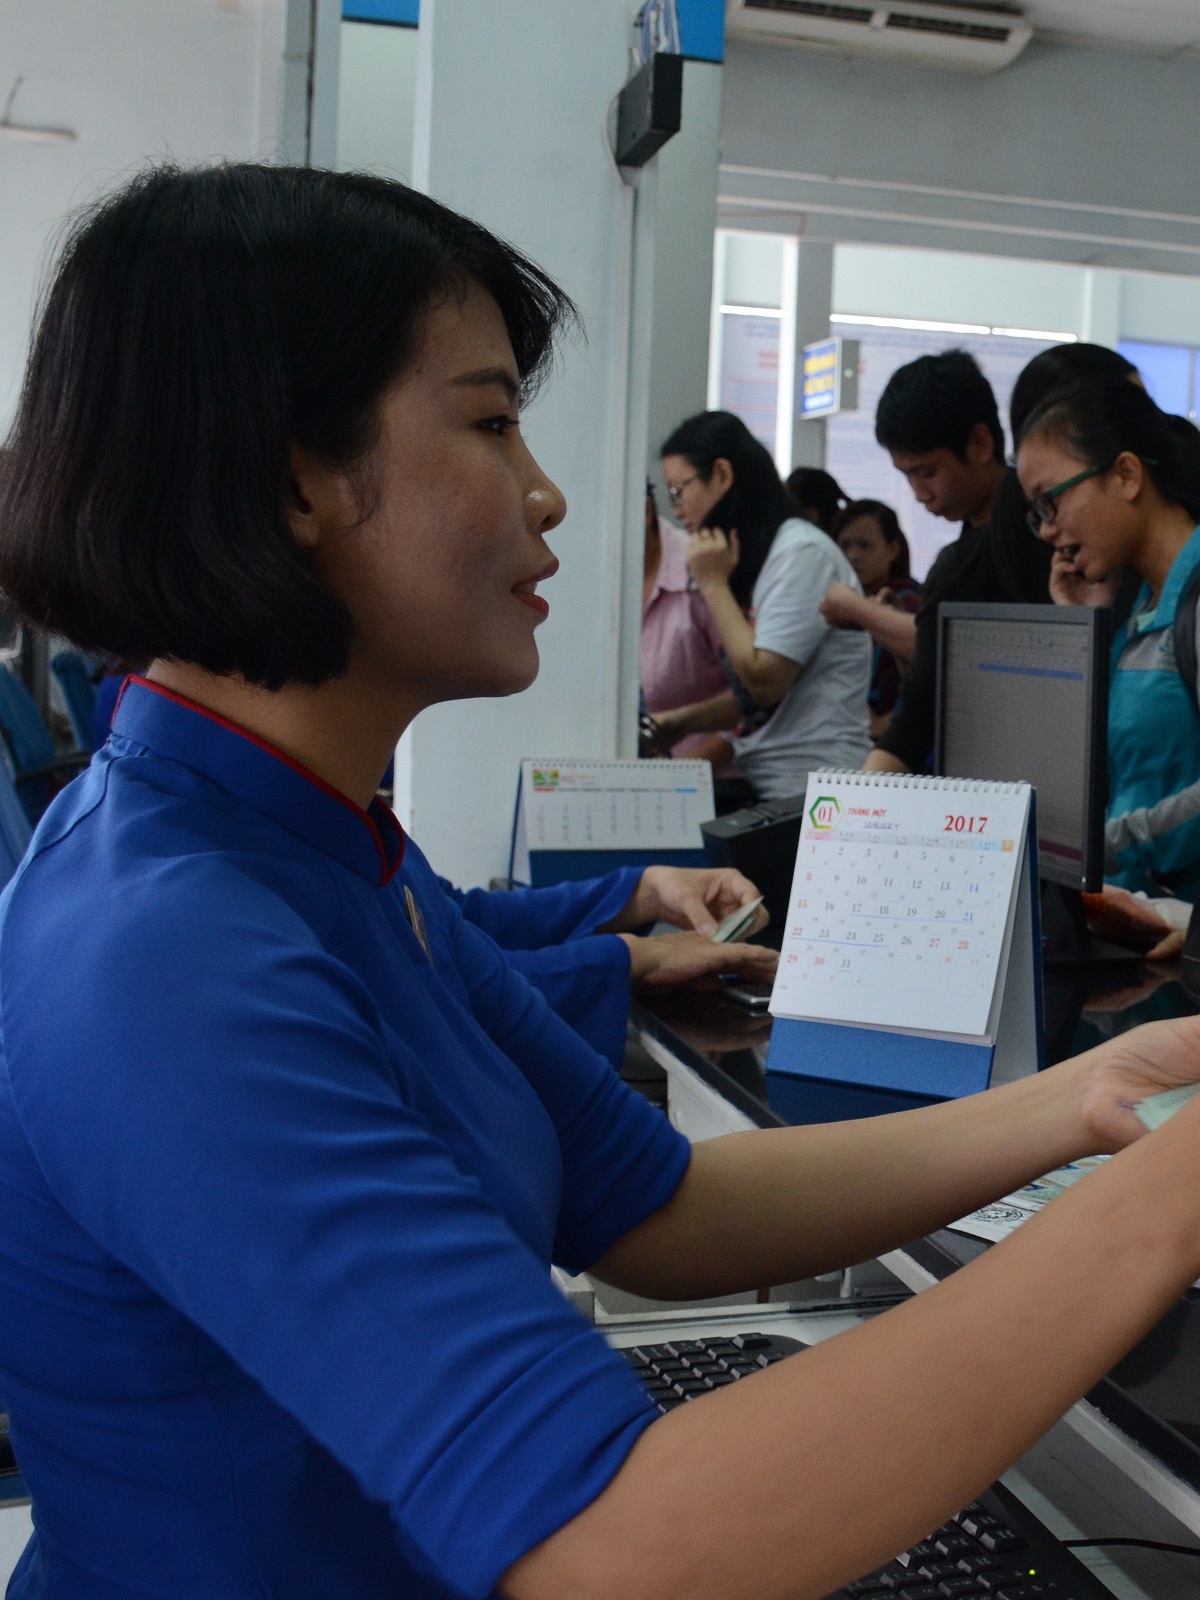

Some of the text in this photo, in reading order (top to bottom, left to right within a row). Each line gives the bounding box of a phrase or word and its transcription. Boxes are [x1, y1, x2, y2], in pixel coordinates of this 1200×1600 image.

[818, 806, 834, 822] 01
[943, 815, 989, 833] 2017
[837, 846, 844, 856] 2
[864, 848, 871, 858] 3
[893, 849, 899, 859] 4
[921, 851, 927, 861] 5
[949, 854, 955, 863] 6
[979, 855, 985, 865] 7
[806, 872, 979, 893] 8 9 10 11 12 13 14
[797, 899, 974, 921] 15 16 17 18 19 20 21
[791, 927, 969, 950] 22 23 24 25 26 27 28
[787, 954, 851, 968] 29 30 31
